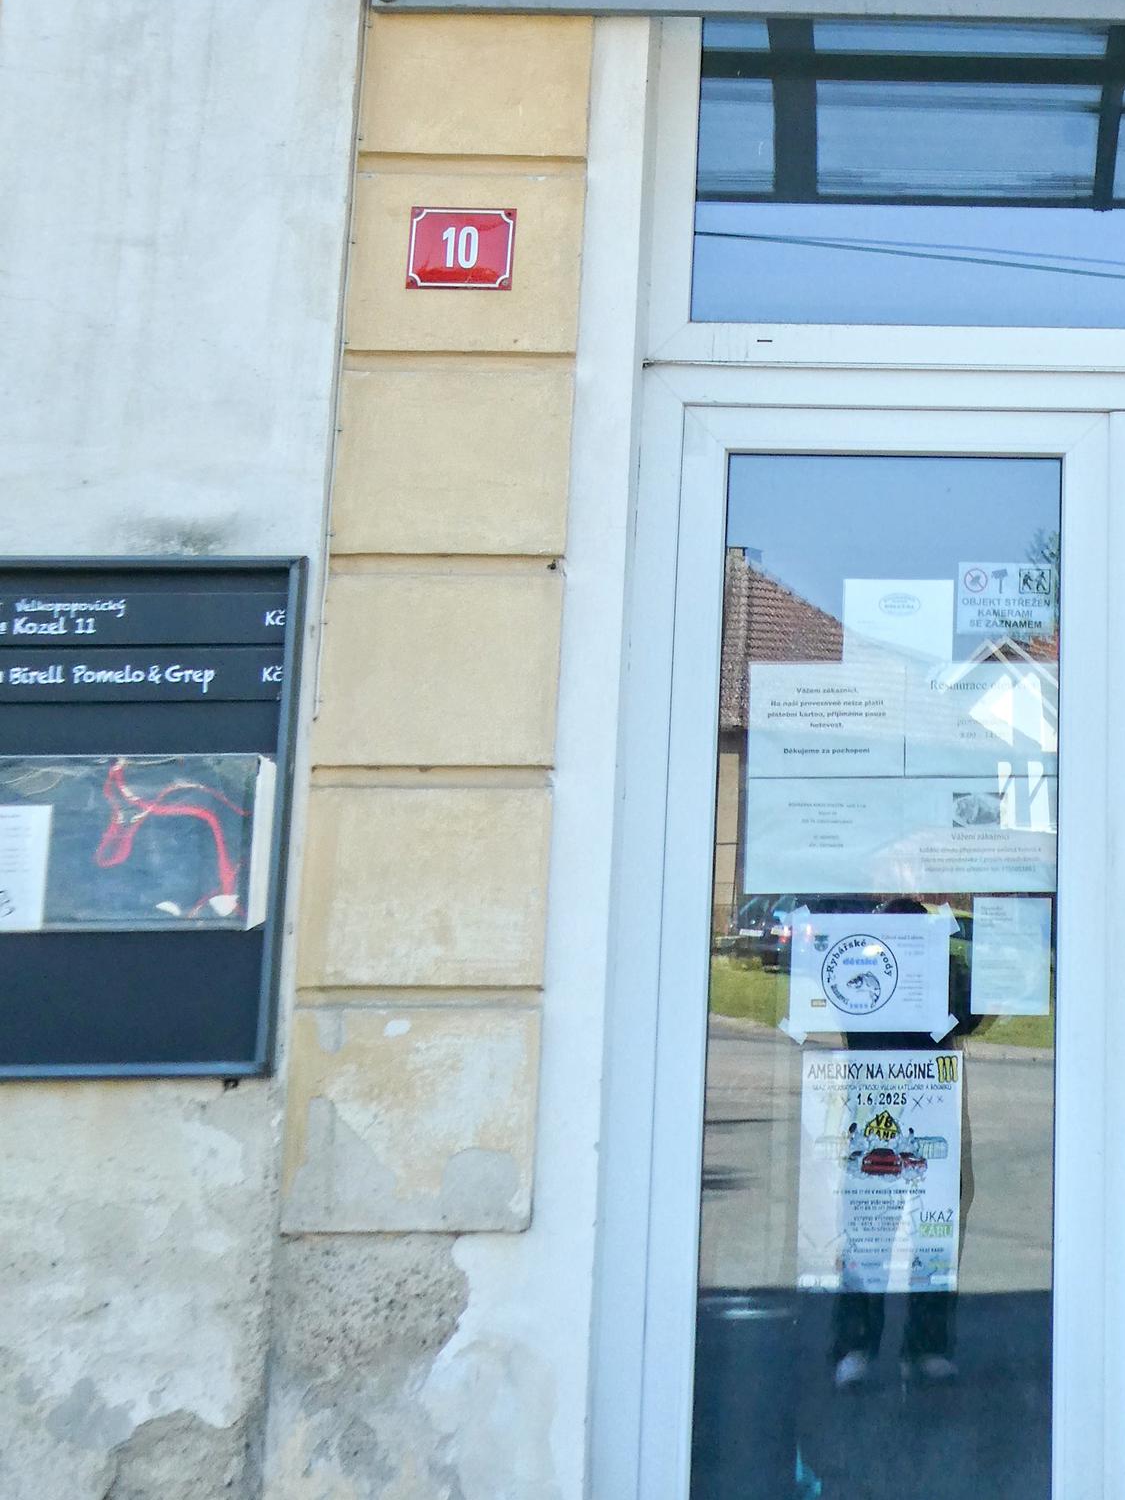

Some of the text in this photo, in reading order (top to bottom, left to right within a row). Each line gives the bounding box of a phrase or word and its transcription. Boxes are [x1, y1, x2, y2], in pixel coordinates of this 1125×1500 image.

[442, 226, 479, 269] 10
[961, 598, 1001, 607] OBJEKT
[977, 609, 1033, 618] KAMERAMI
[12, 617, 68, 635] Kozel
[74, 617, 97, 635] 11
[265, 610, 286, 627] Kč
[9, 665, 65, 685] Birell
[72, 664, 145, 684] Pomelo
[164, 665, 215, 694] Grep
[262, 666, 283, 683] Kč
[866, 1063, 885, 1080] NA
[857, 1092, 908, 1106] 1.6.2025
[920, 1208, 954, 1223] UKAŽ
